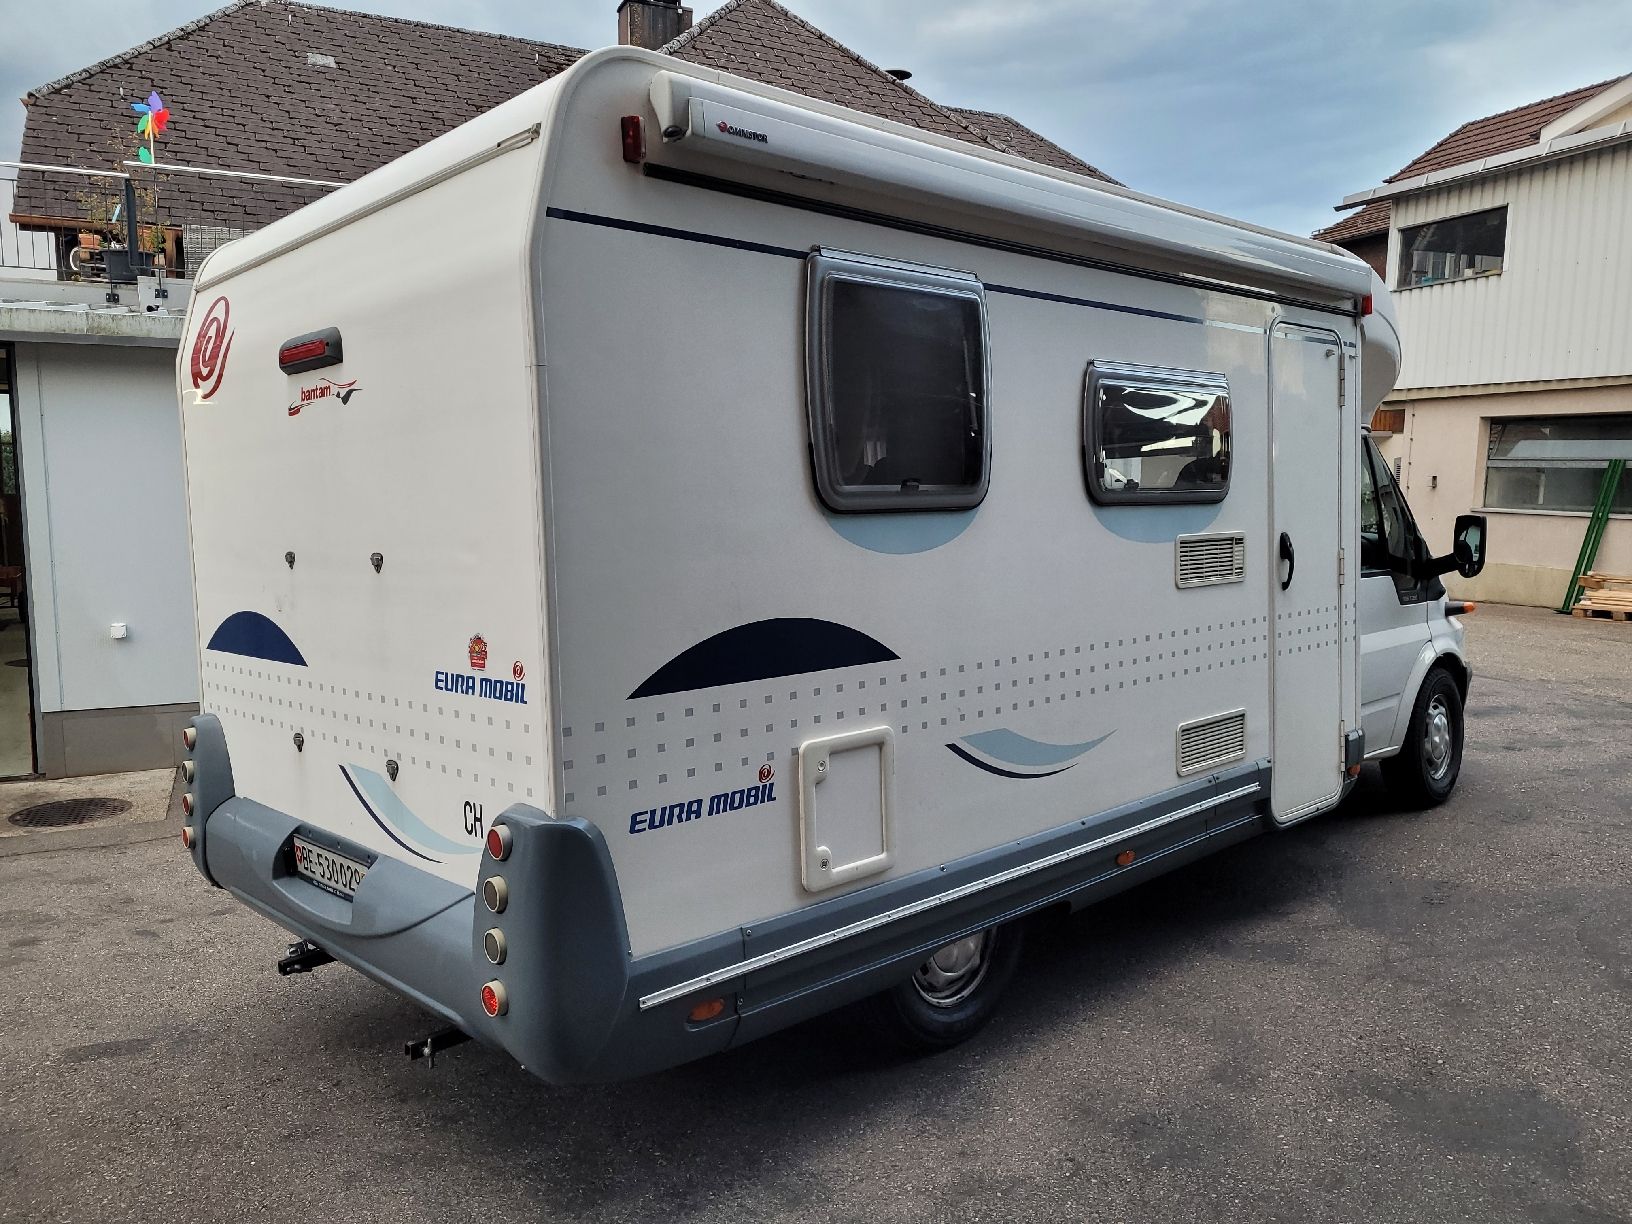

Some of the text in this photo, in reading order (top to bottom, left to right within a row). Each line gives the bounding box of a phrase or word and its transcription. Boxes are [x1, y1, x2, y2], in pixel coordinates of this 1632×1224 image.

[301, 384, 331, 402] bantam
[434, 670, 528, 705] EURA MOBIL
[463, 800, 484, 839] CH
[629, 782, 777, 835] EURA MOBIL
